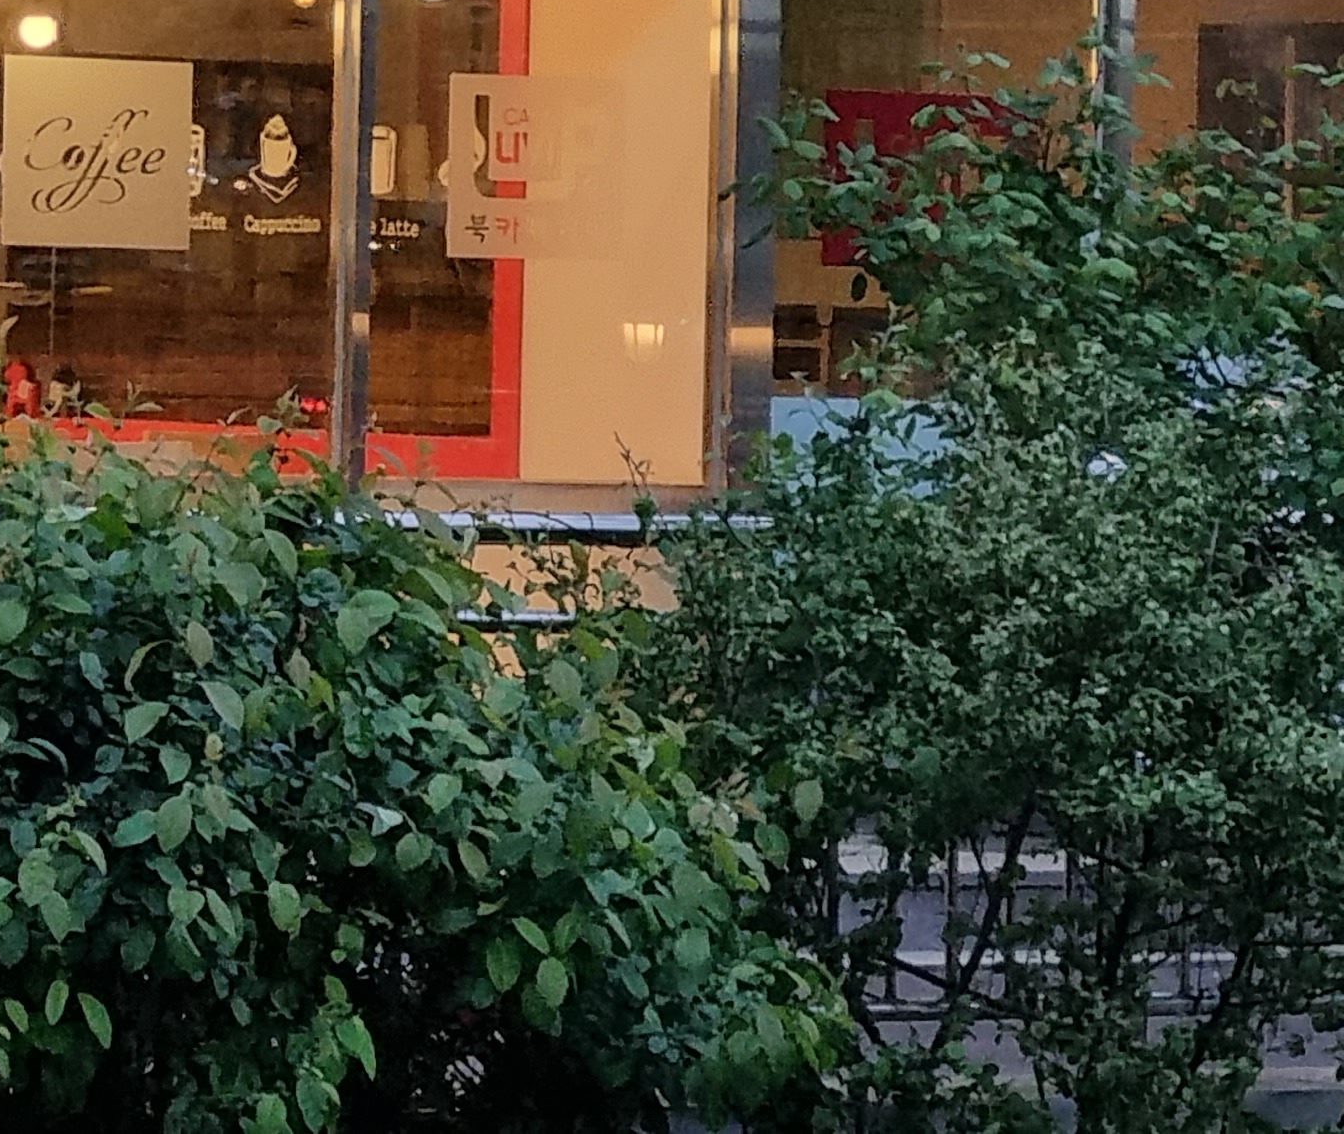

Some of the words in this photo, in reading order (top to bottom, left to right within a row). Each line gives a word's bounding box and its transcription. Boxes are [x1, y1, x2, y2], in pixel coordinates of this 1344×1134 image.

[23, 107, 167, 214] Coffee
[243, 214, 321, 235] Cappuccino
[379, 217, 420, 238] latte
